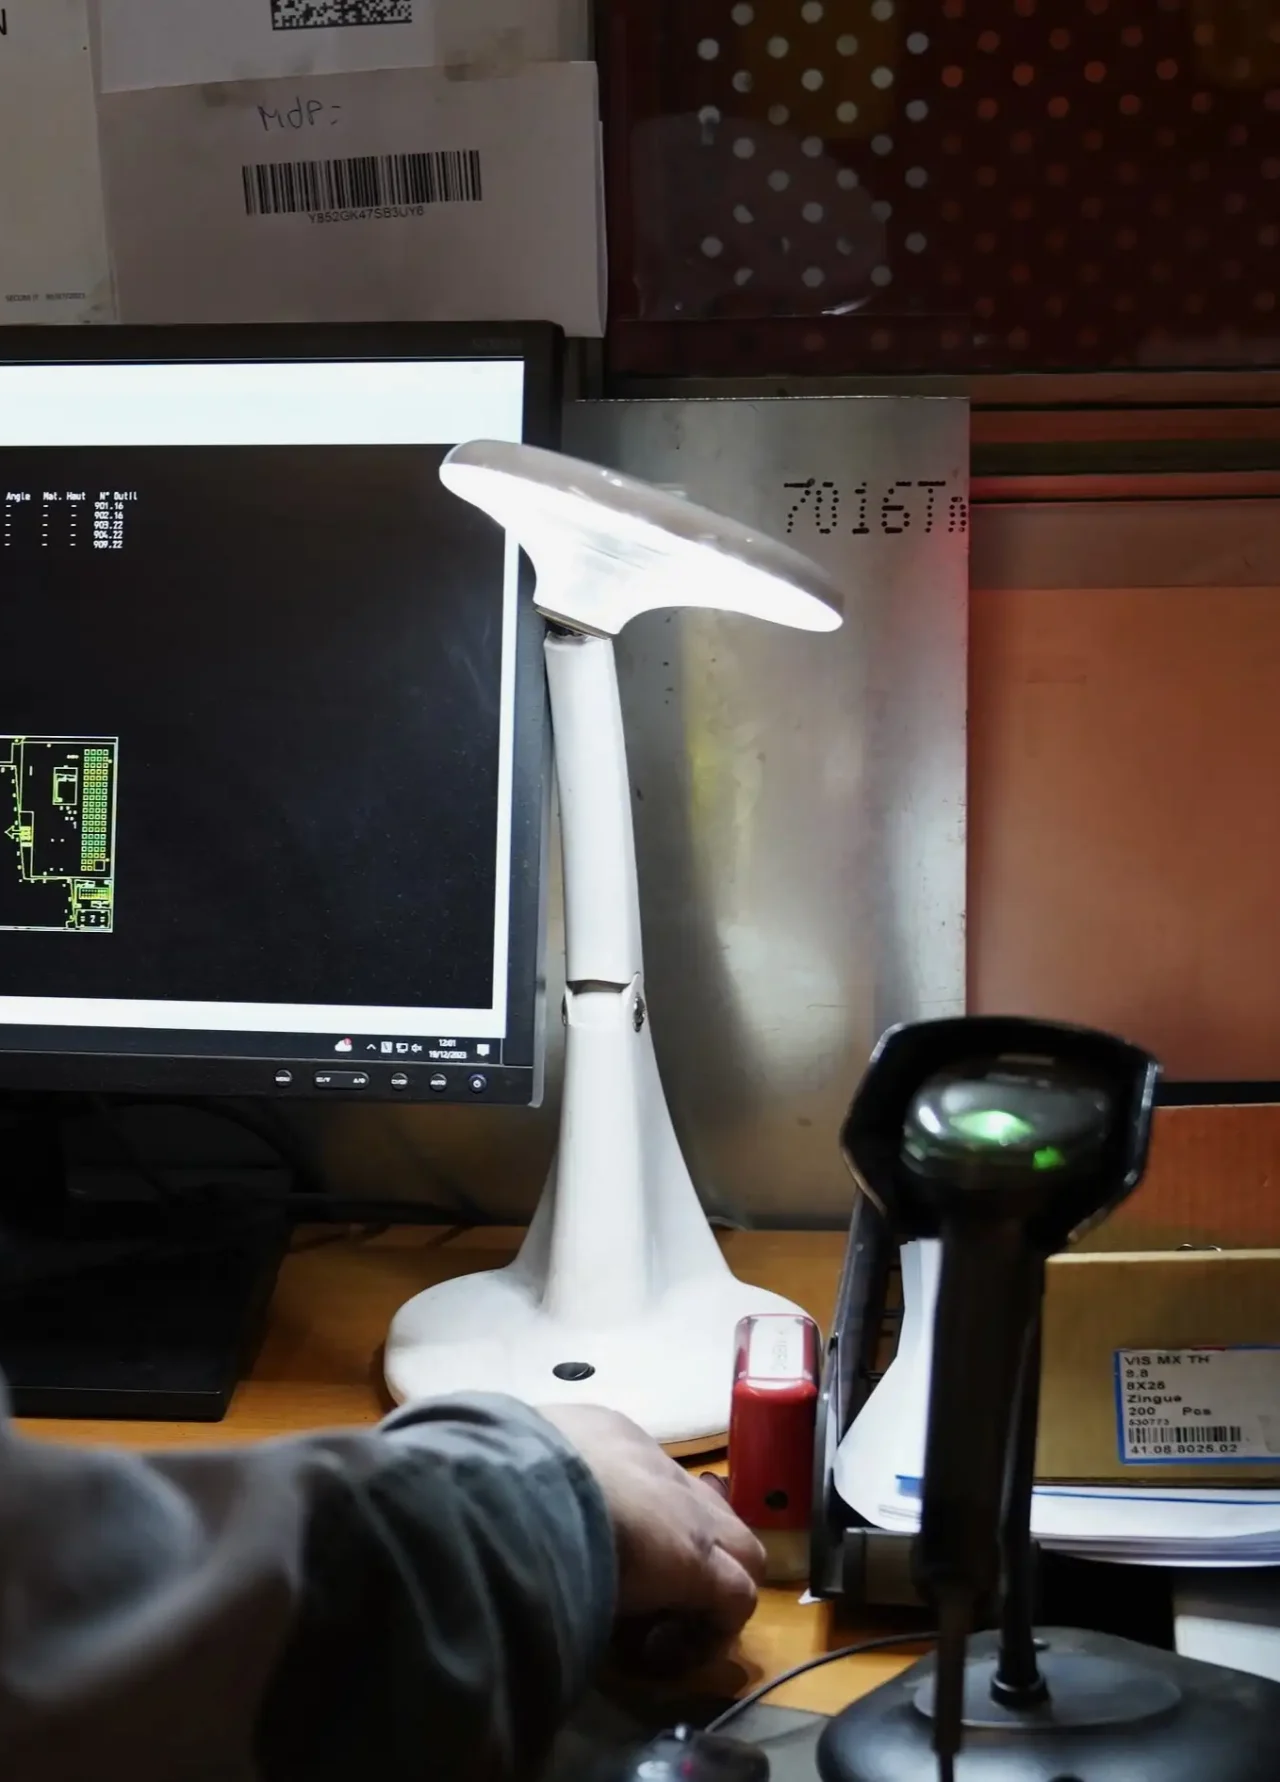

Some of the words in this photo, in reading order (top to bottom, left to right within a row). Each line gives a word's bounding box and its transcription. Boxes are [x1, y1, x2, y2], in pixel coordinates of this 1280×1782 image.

[5, 492, 31, 503] Angle
[66, 491, 86, 501] Haut
[113, 491, 138, 501] Outil
[94, 501, 124, 510] 901.16
[94, 510, 124, 520] 902.16
[93, 520, 124, 530] 903.22
[93, 530, 124, 539] 904.22
[93, 540, 123, 549] 909.22
[1124, 1356, 1152, 1366] VIS
[1156, 1355, 1182, 1365] MX
[1186, 1355, 1210, 1364] TH
[1127, 1394, 1182, 1405] Zingue
[1128, 1407, 1156, 1416] 200
[1182, 1406, 1212, 1416] Pcs
